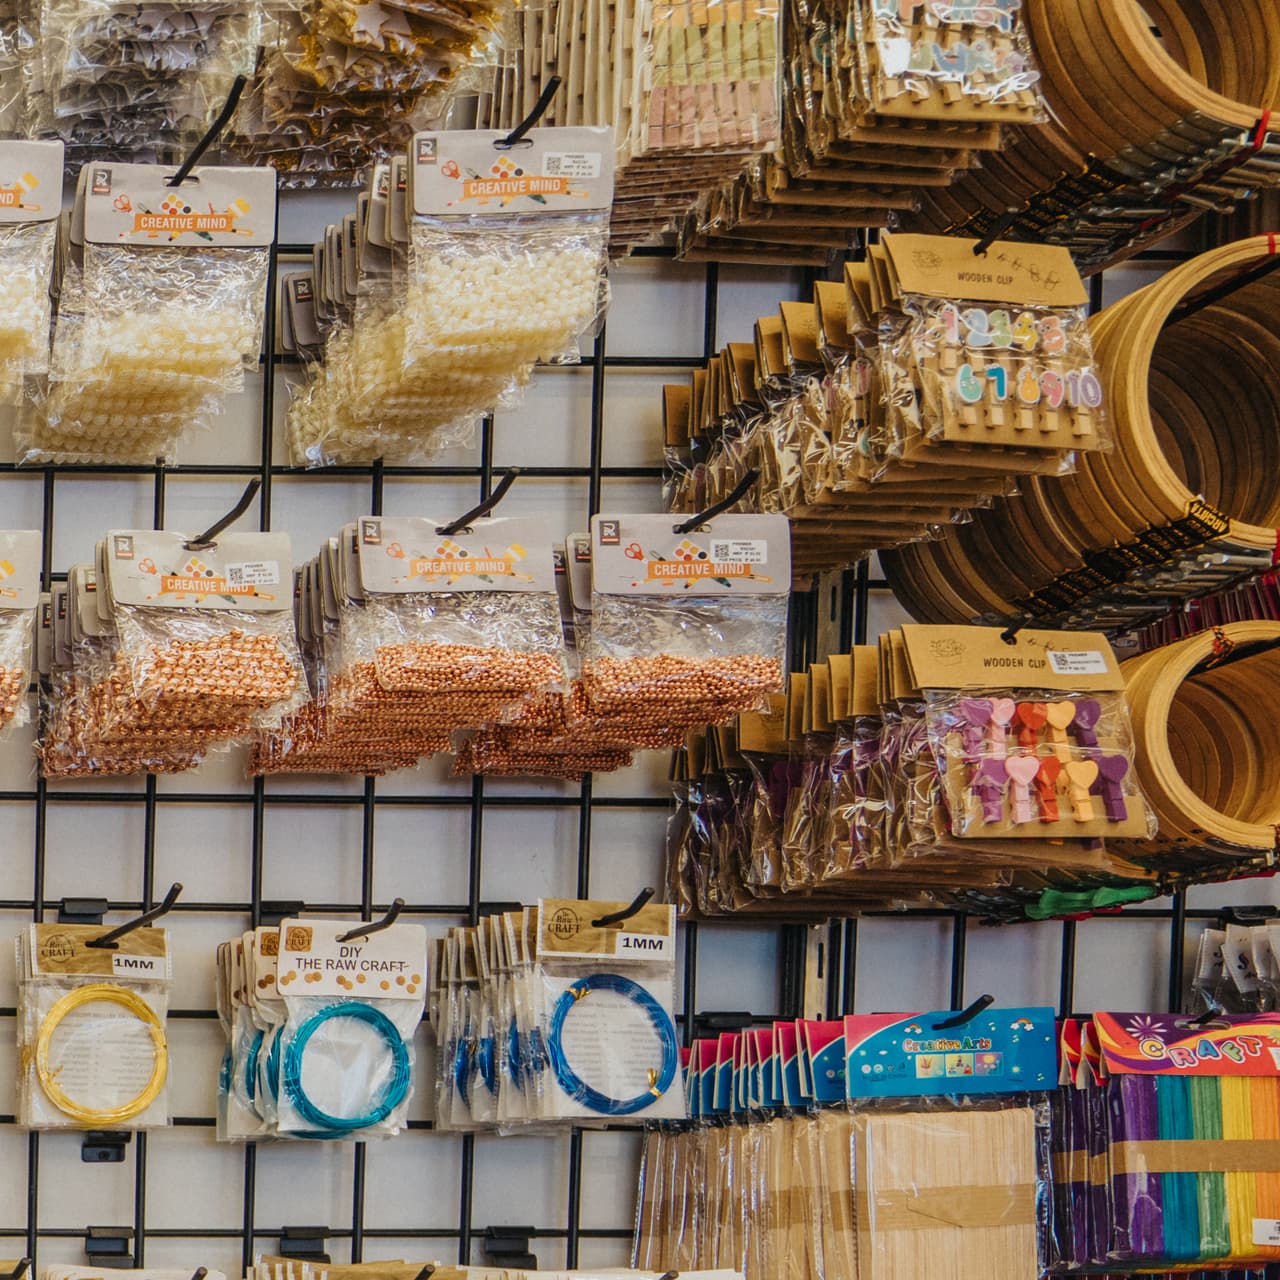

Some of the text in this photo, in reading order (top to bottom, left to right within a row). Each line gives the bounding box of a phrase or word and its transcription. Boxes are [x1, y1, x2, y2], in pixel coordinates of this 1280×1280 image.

[470, 179, 561, 196] CREATIVE MIND
[140, 217, 227, 230] CREATIVE MIND
[958, 271, 1015, 285] WOODEN CLIP
[416, 559, 506, 573] CREATIVE MIND
[653, 560, 745, 577] CREATIVE MIND
[167, 578, 216, 593] CREATIVE
[983, 657, 1024, 669] WOODEN
[548, 923, 580, 934] CRAFT
[622, 937, 664, 950] 1MM
[41, 948, 75, 958] CRAFT
[340, 946, 362, 958] DIY
[114, 958, 154, 970] 1MM
[295, 958, 407, 973] THE RAW CRAFT
[903, 1038, 991, 1052] Creative Arts
[1139, 1036, 1263, 1070] CRAFT
